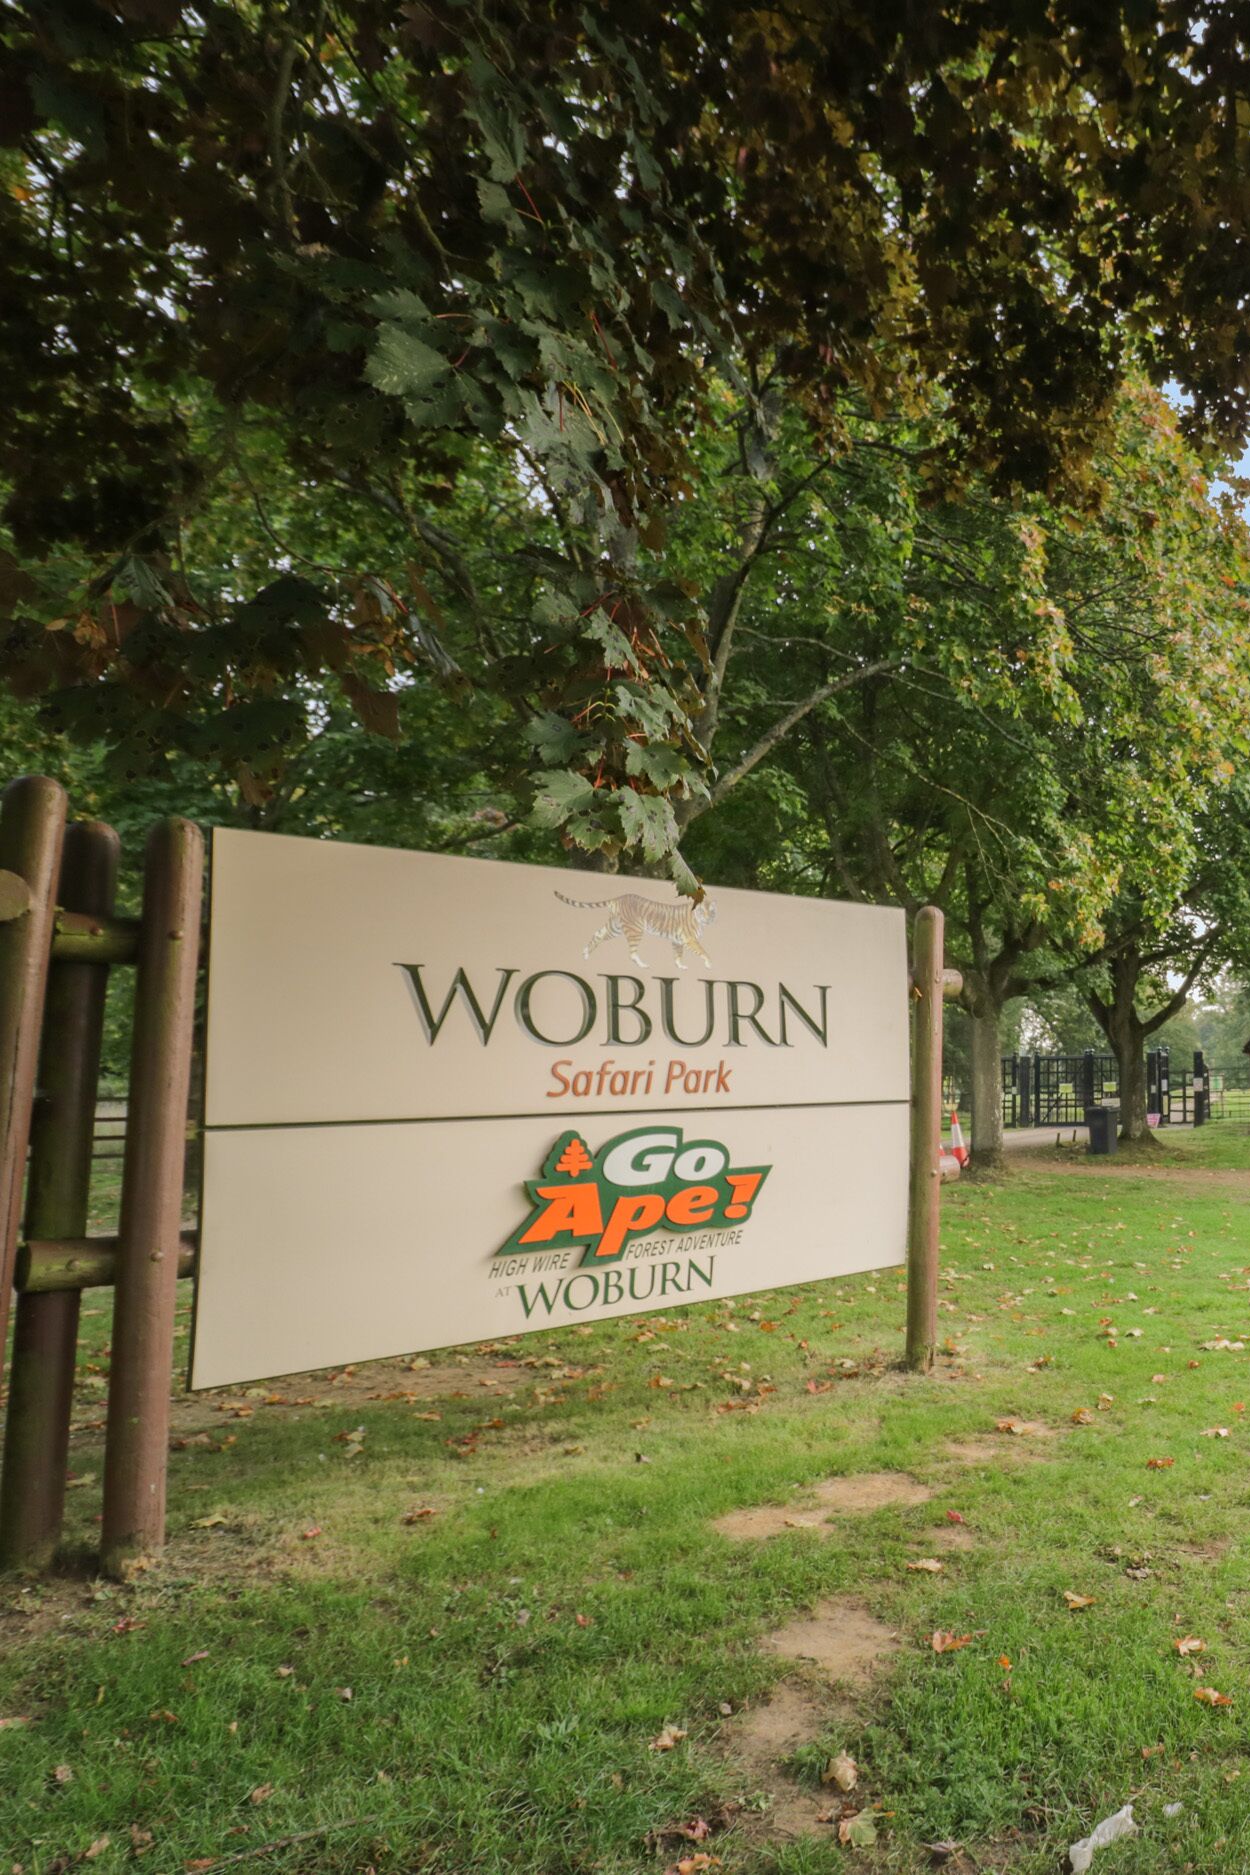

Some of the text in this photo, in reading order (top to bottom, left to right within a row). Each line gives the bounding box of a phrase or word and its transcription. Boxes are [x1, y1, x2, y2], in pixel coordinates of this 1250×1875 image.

[391, 962, 832, 1049] WOBURN
[546, 1059, 732, 1098] Safari Park
[602, 1133, 726, 1187] Go
[517, 1172, 762, 1257] Ape!
[488, 1229, 744, 1279] HIGH WIRE FOREST ADVENTURE
[494, 1255, 717, 1320] AT WOBURN
